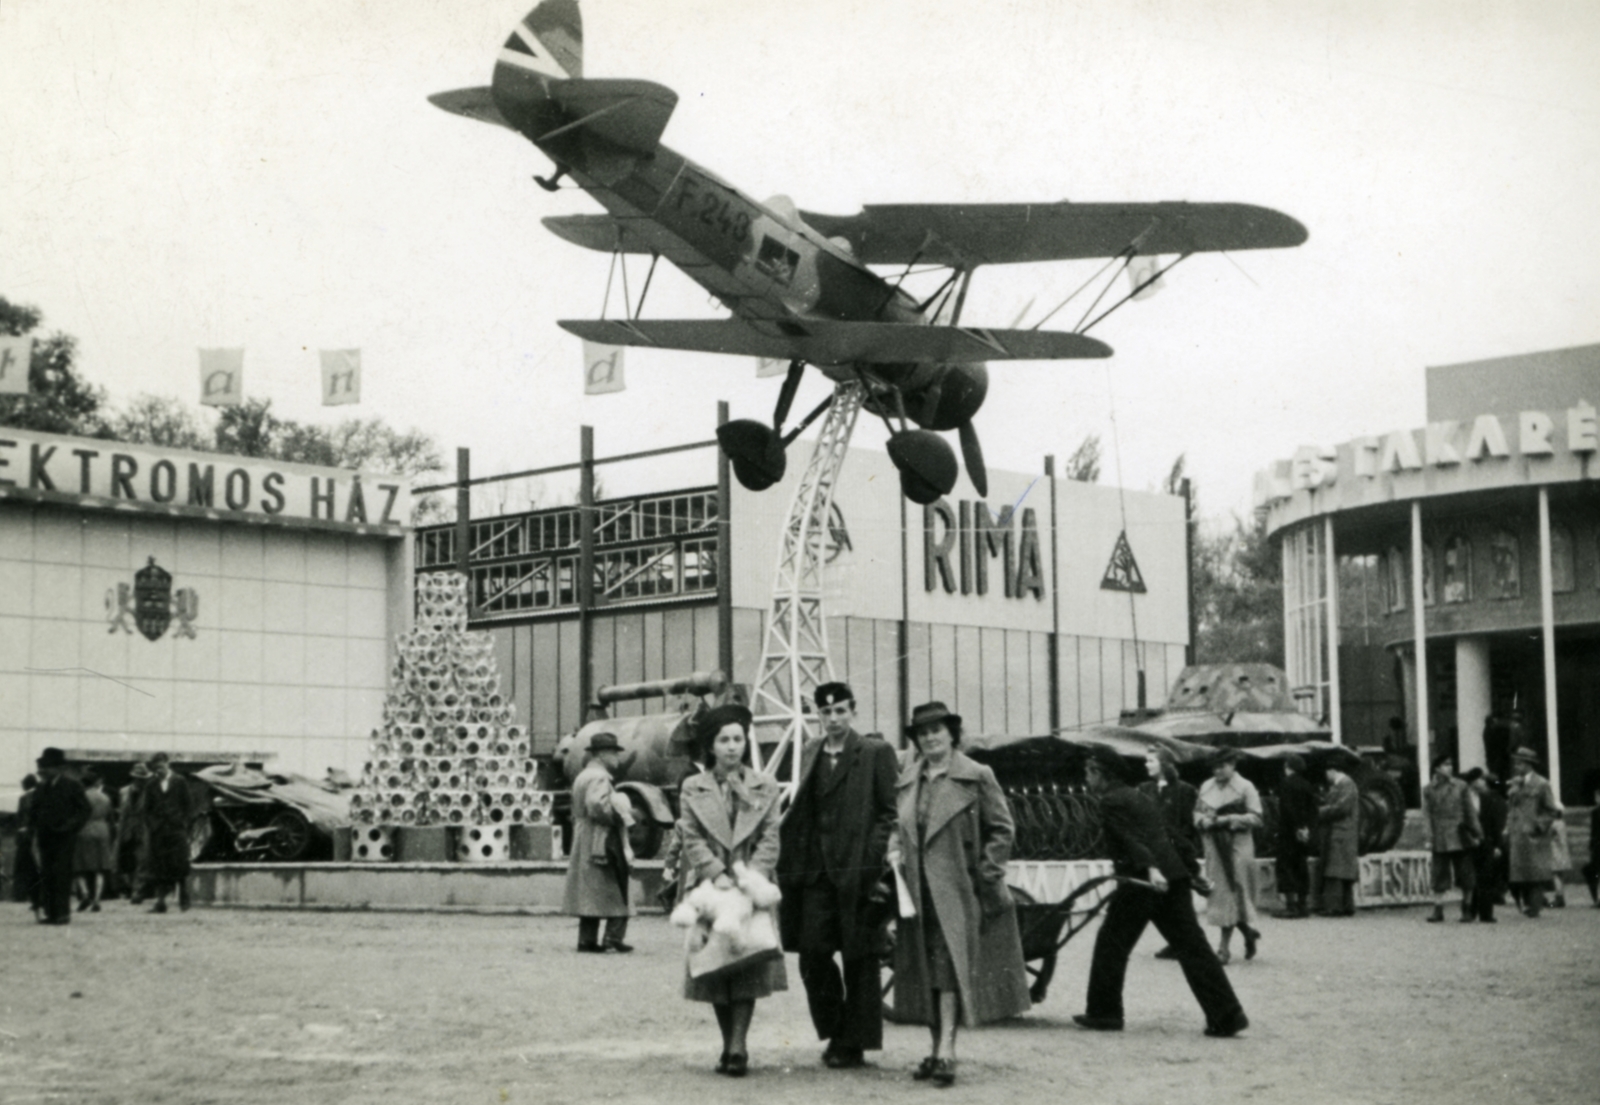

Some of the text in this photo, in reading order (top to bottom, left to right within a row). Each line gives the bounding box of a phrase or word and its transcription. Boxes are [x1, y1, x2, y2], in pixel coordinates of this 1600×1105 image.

[203, 369, 236, 397] a
[328, 369, 355, 396] n
[587, 350, 618, 386] d
[310, 474, 402, 527] HÁZ
[923, 499, 1046, 602] RIMA
